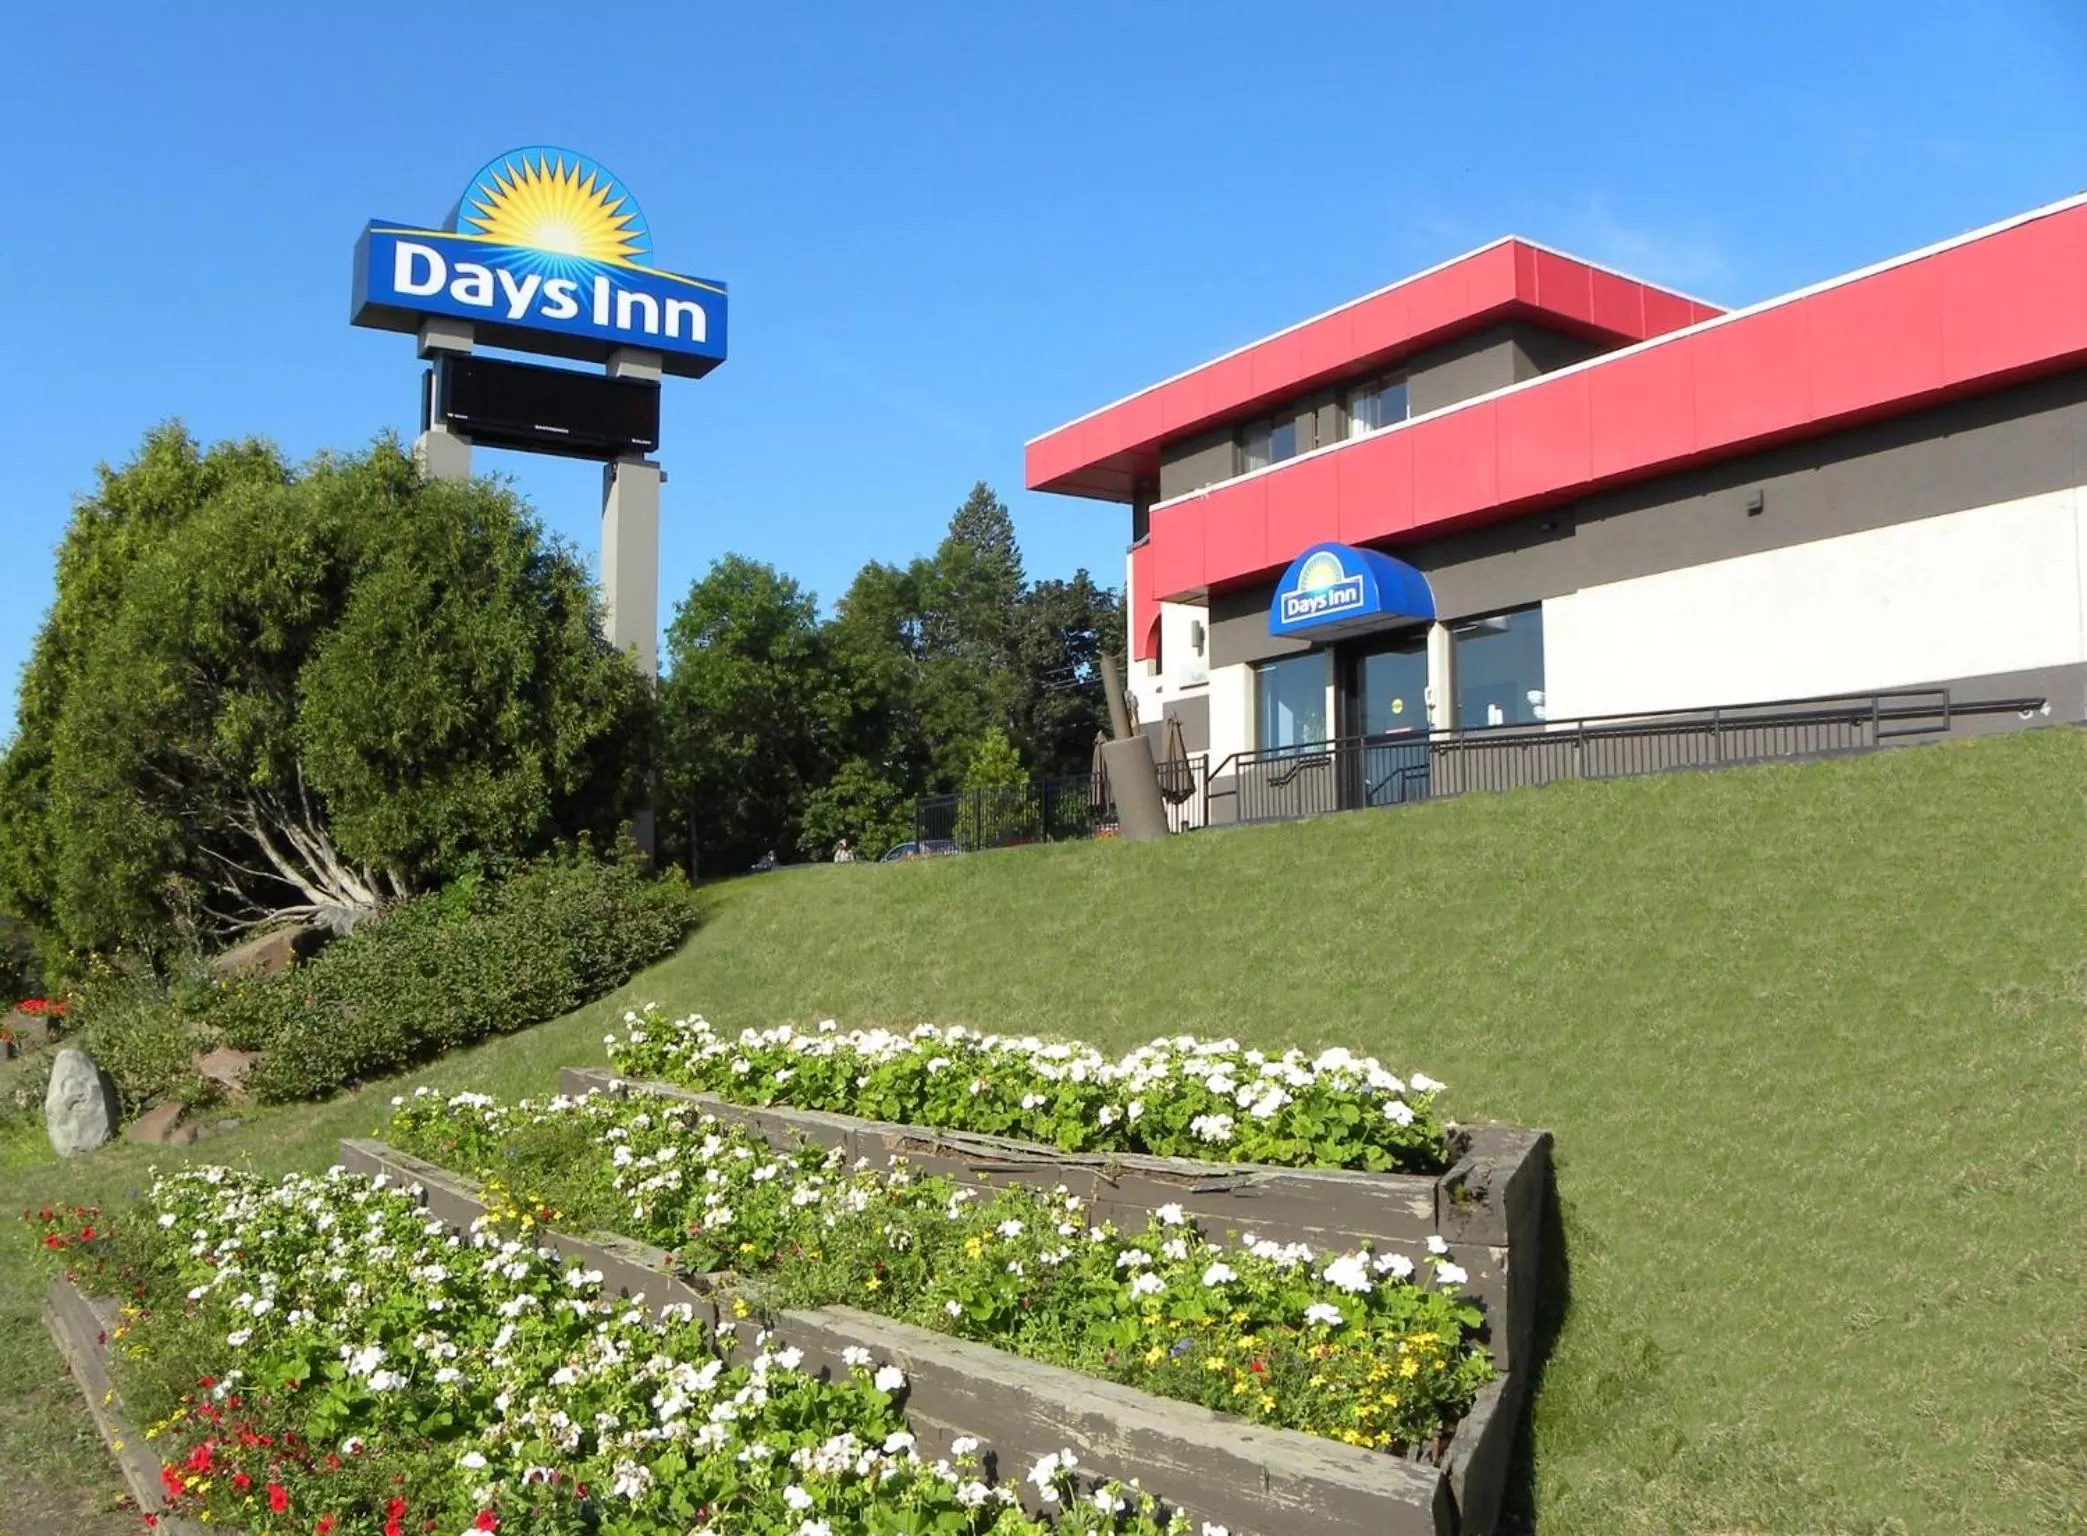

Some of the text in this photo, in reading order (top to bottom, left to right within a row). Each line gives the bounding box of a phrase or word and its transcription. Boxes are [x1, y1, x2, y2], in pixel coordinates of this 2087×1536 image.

[393, 240, 707, 343] Days Inn
[1287, 588, 1357, 616] Days Inn
